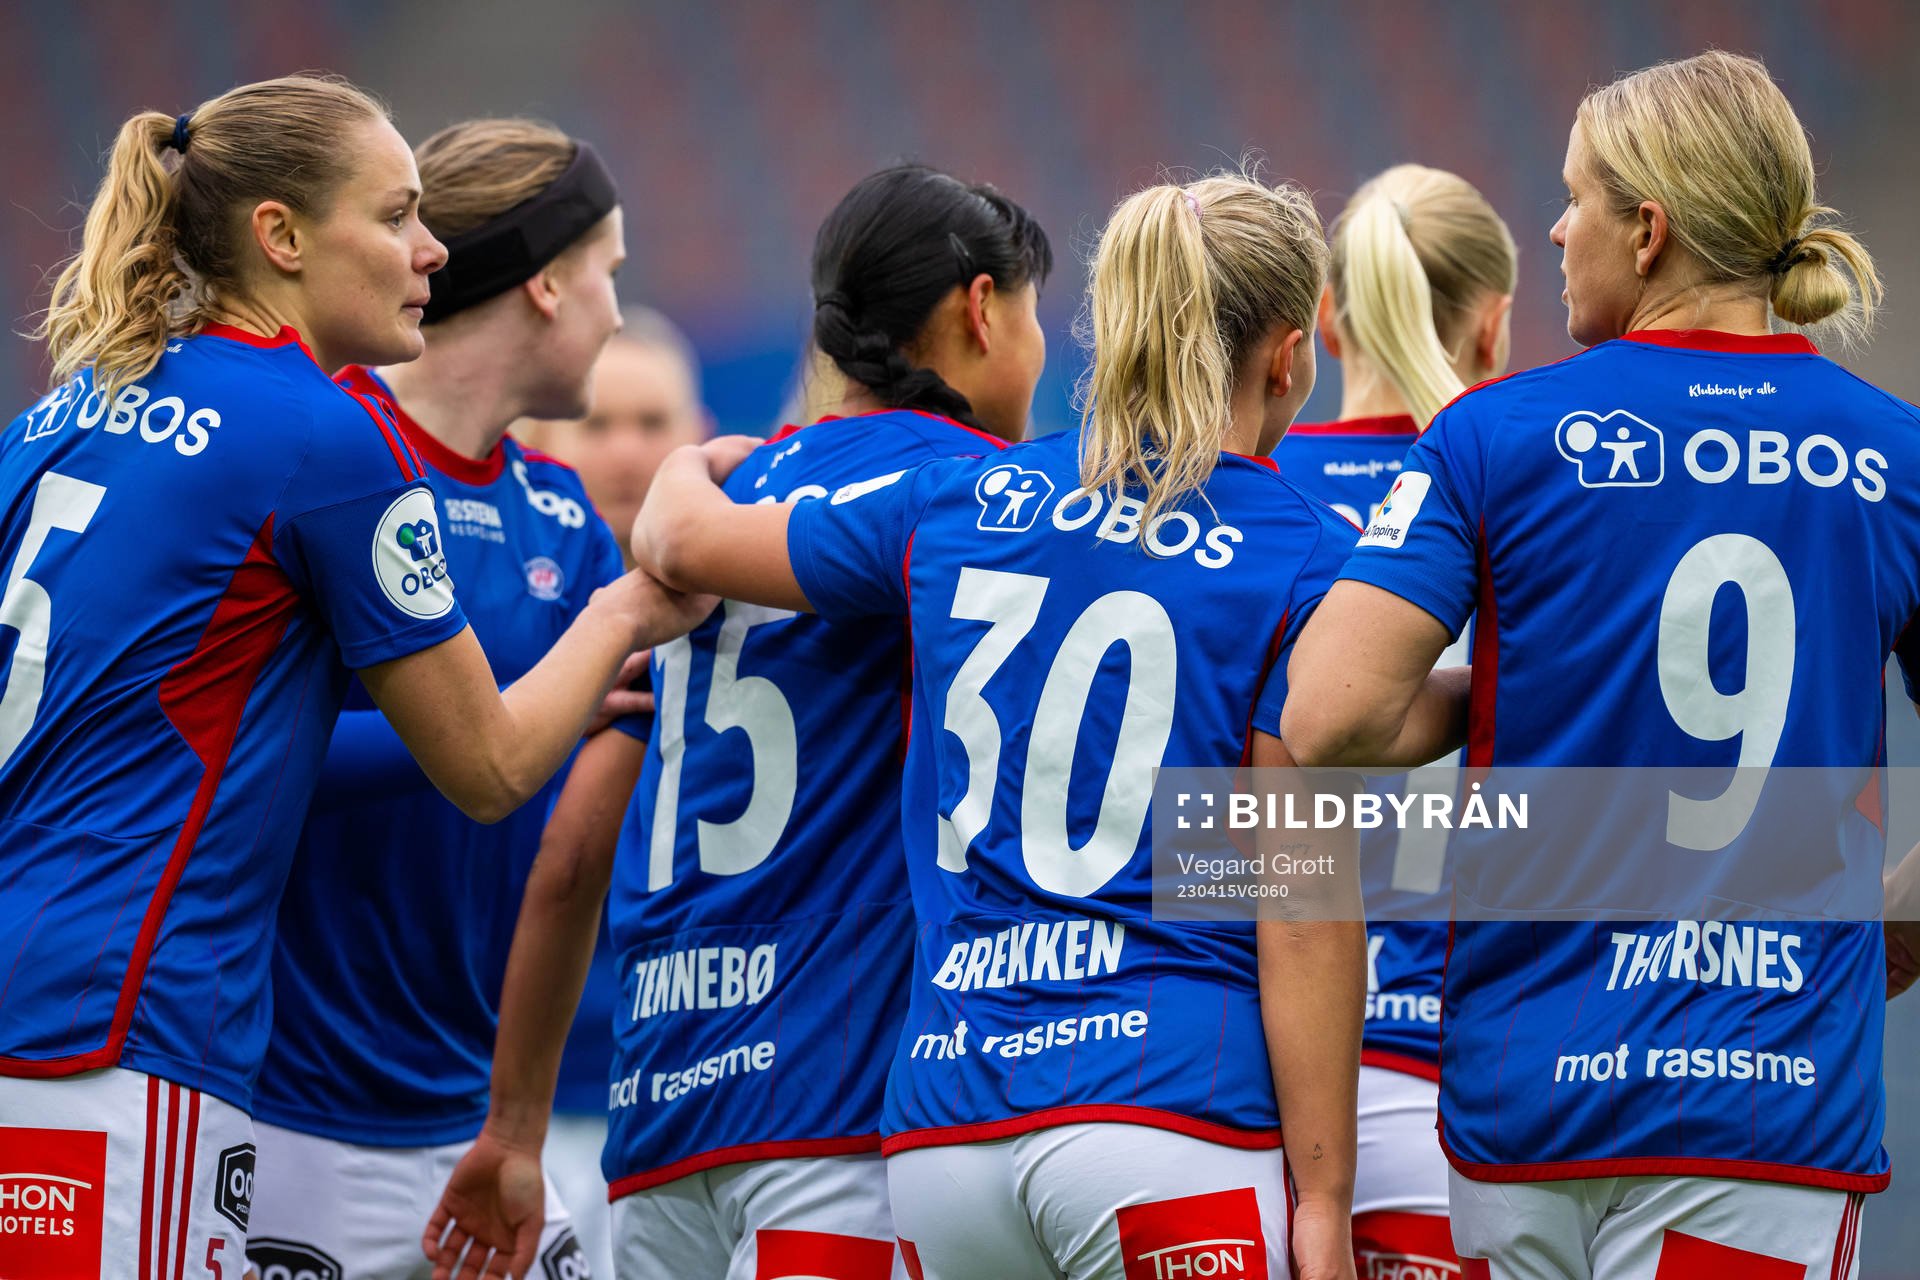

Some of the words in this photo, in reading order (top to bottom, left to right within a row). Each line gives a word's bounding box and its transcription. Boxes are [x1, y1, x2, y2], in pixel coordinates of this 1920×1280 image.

[77, 382, 221, 456] OBOS
[1689, 383, 1737, 397] Klubben
[1738, 384, 1754, 399] for
[1757, 382, 1778, 395] alle
[1683, 428, 1889, 502] OBOS
[1052, 487, 1243, 569] OBOS
[1656, 533, 1796, 851] 9
[648, 599, 797, 893] 15
[936, 566, 1178, 897] 30
[632, 943, 778, 1022] TENNEBØ
[931, 919, 1126, 992] BREKKEN
[1606, 920, 1804, 992] THORSNES
[982, 1009, 1149, 1058] rasisme
[1555, 1043, 1628, 1083] mot
[1646, 1047, 1816, 1086] rasisme
[651, 1041, 776, 1102] rasisme
[0, 1172, 92, 1212] HON
[0, 1215, 75, 1236] OTELS
[1137, 1238, 1255, 1280] THON
